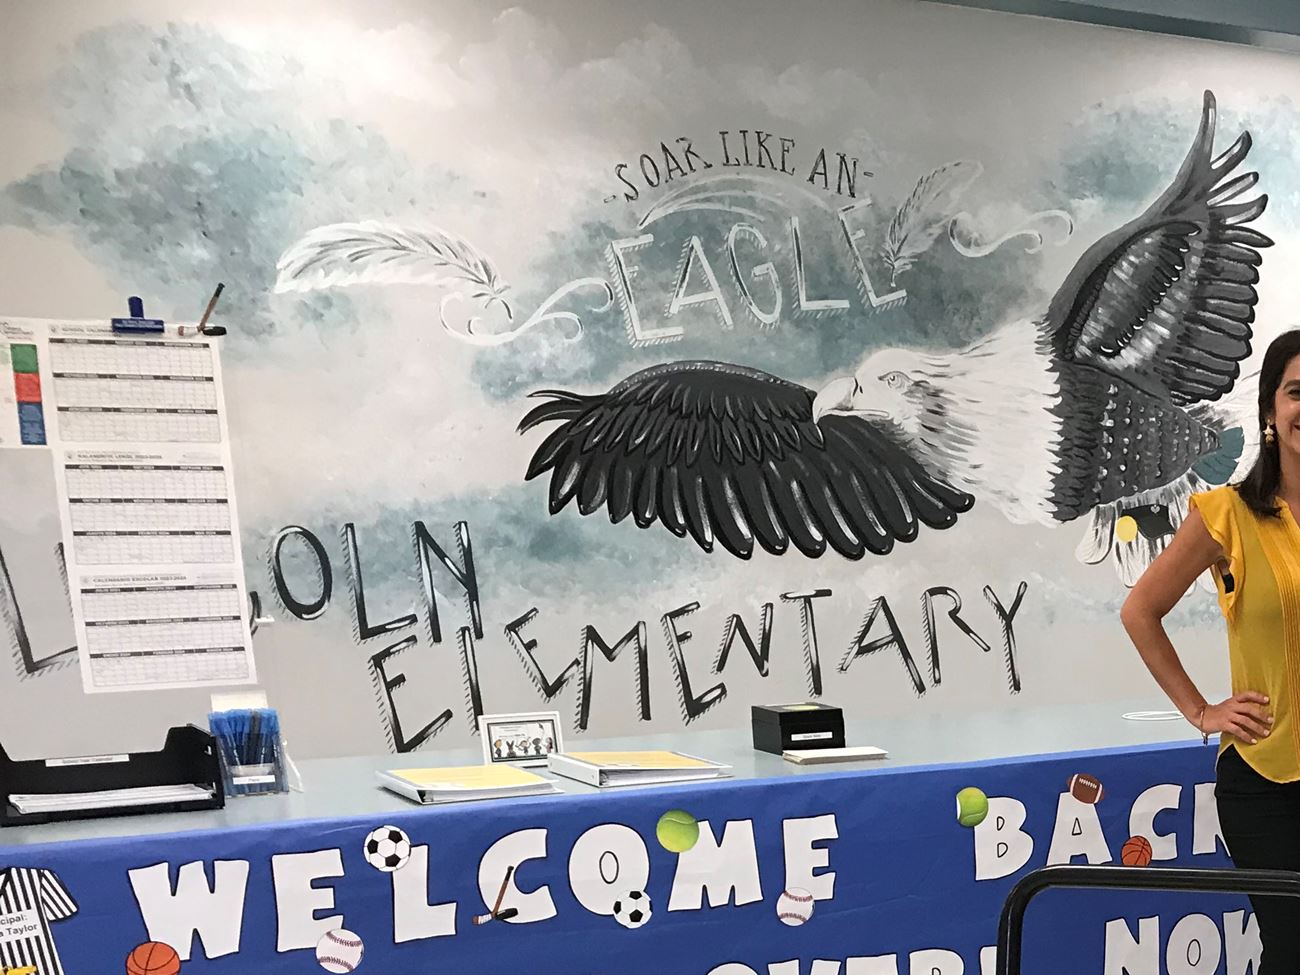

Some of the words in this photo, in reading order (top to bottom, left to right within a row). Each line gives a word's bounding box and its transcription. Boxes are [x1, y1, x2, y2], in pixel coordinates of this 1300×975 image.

[719, 130, 796, 176] LIKE
[605, 199, 908, 347] EAGLE
[6, 924, 38, 937] Taylor
[129, 813, 839, 960] WELCOME
